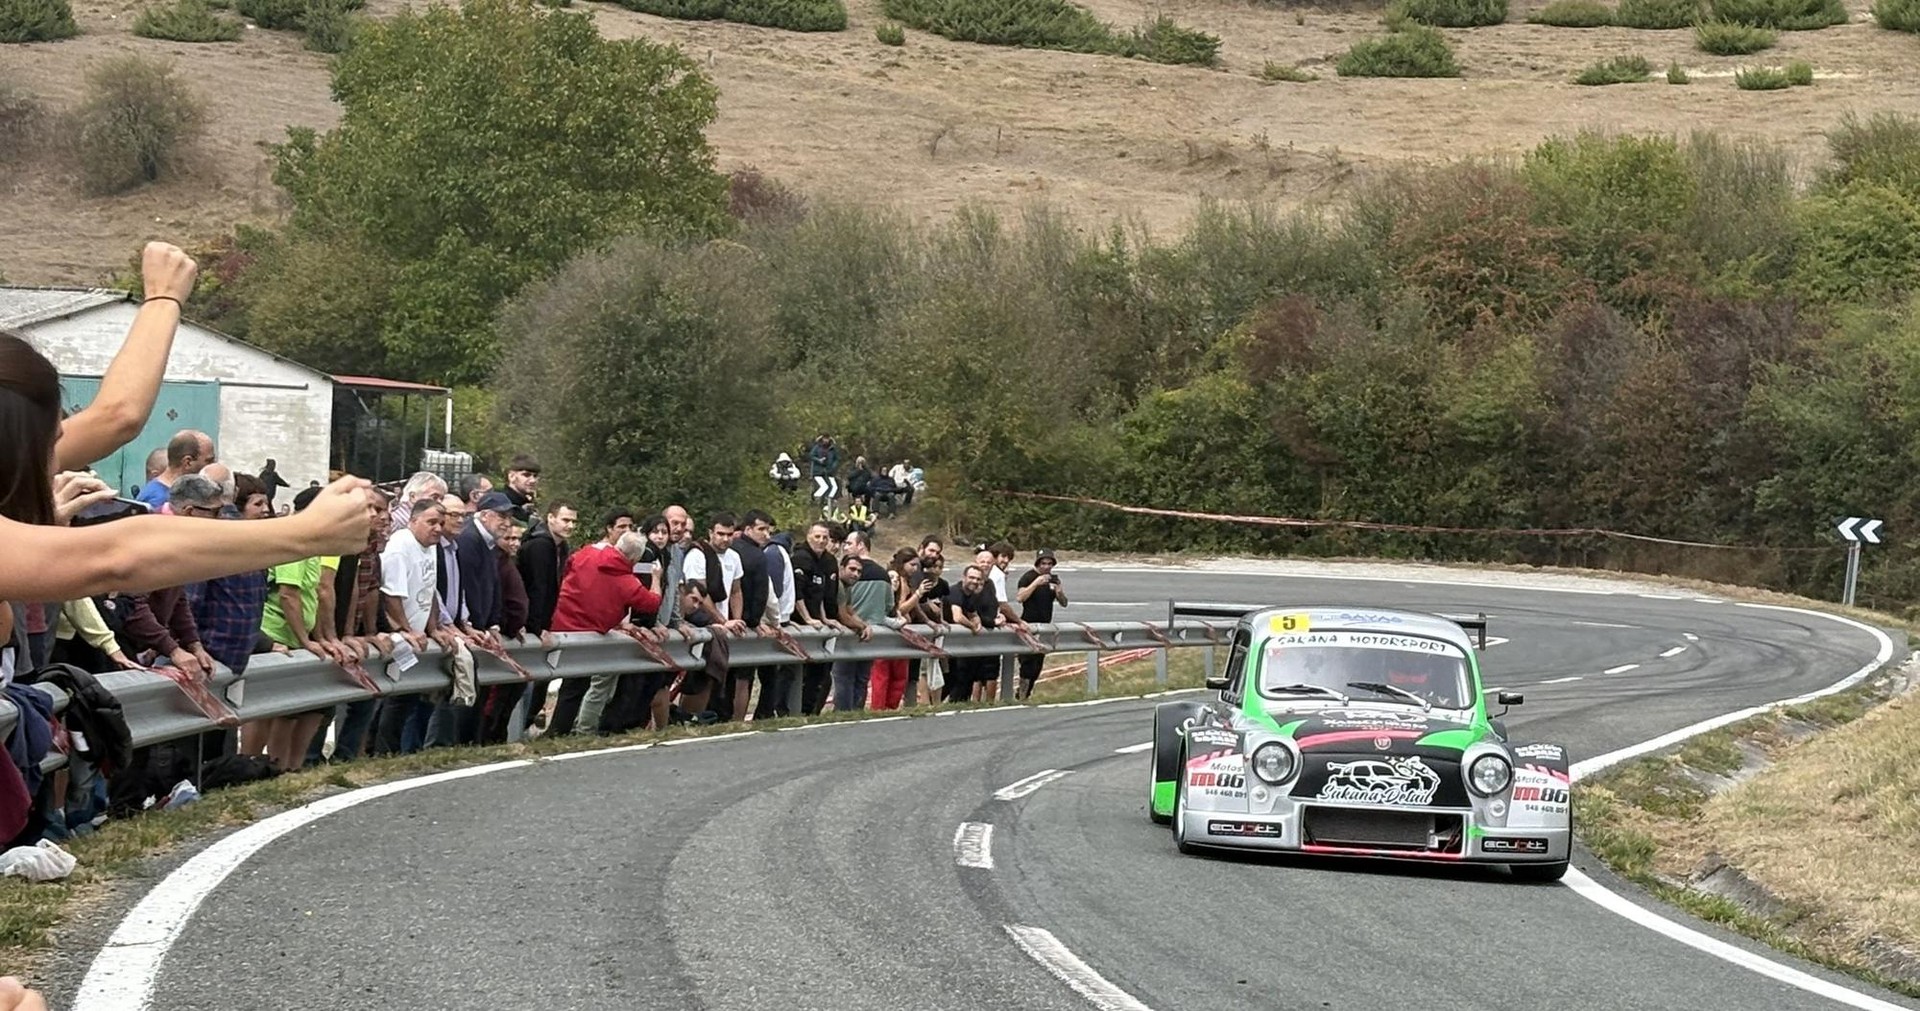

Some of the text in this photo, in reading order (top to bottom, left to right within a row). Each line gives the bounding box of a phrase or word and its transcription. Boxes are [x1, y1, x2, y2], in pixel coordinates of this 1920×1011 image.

[1282, 615, 1297, 630] 5
[1278, 634, 1447, 652] SAKANA MOTORSPORT
[1210, 762, 1244, 773] Motos
[1319, 784, 1433, 804] Sakana Detail
